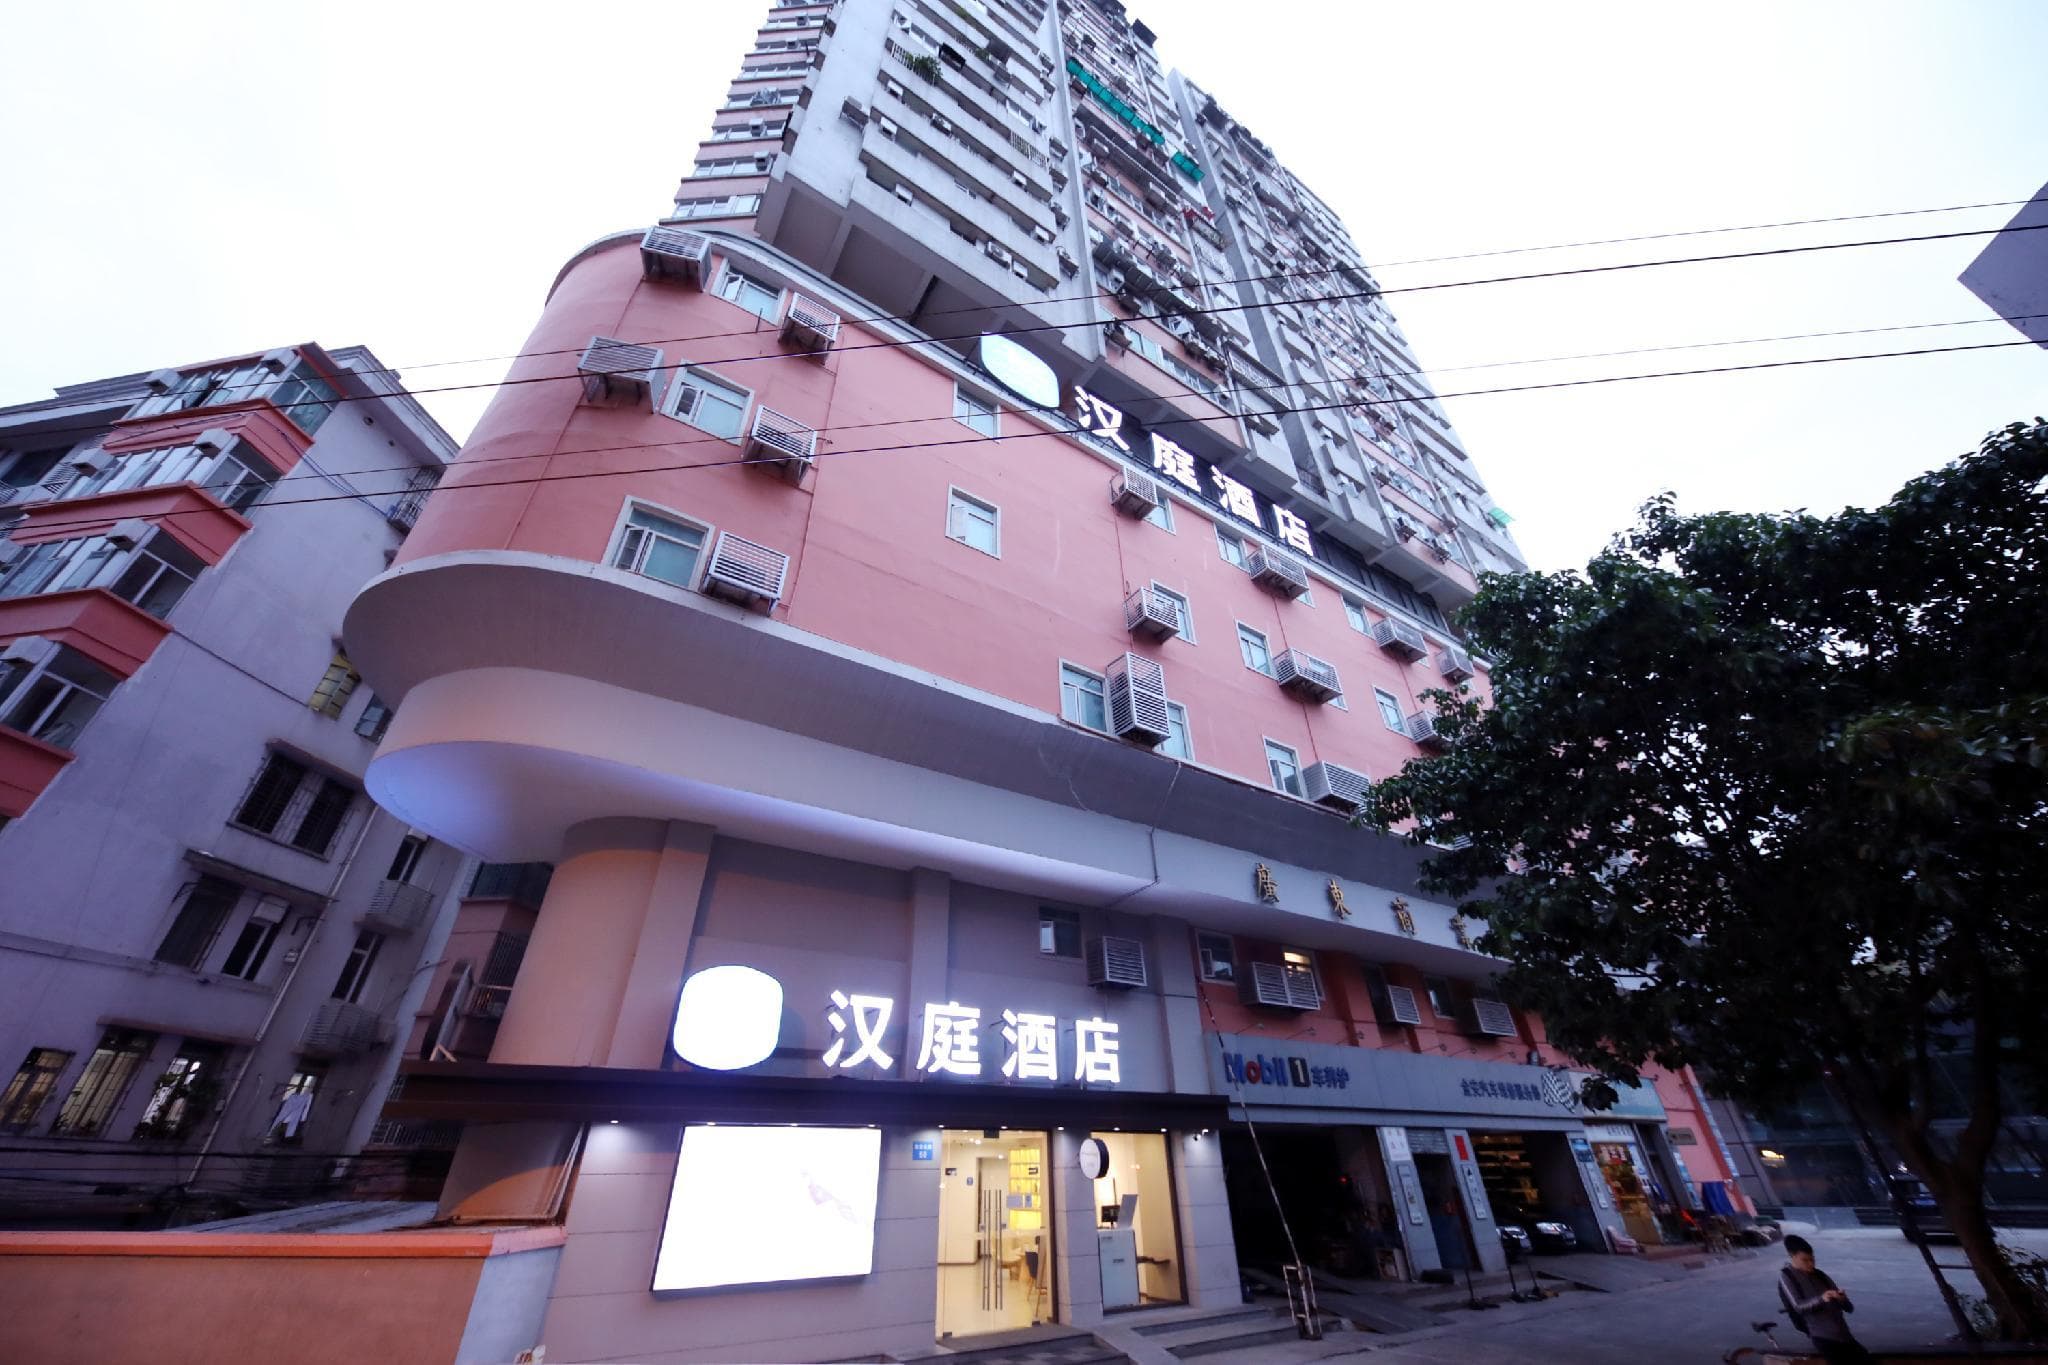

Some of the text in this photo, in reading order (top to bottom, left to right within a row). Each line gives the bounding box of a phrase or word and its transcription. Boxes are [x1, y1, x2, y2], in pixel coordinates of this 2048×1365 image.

[1074, 385, 1314, 556] 汉庭酒店
[823, 990, 1122, 1084] 汉庭酒店
